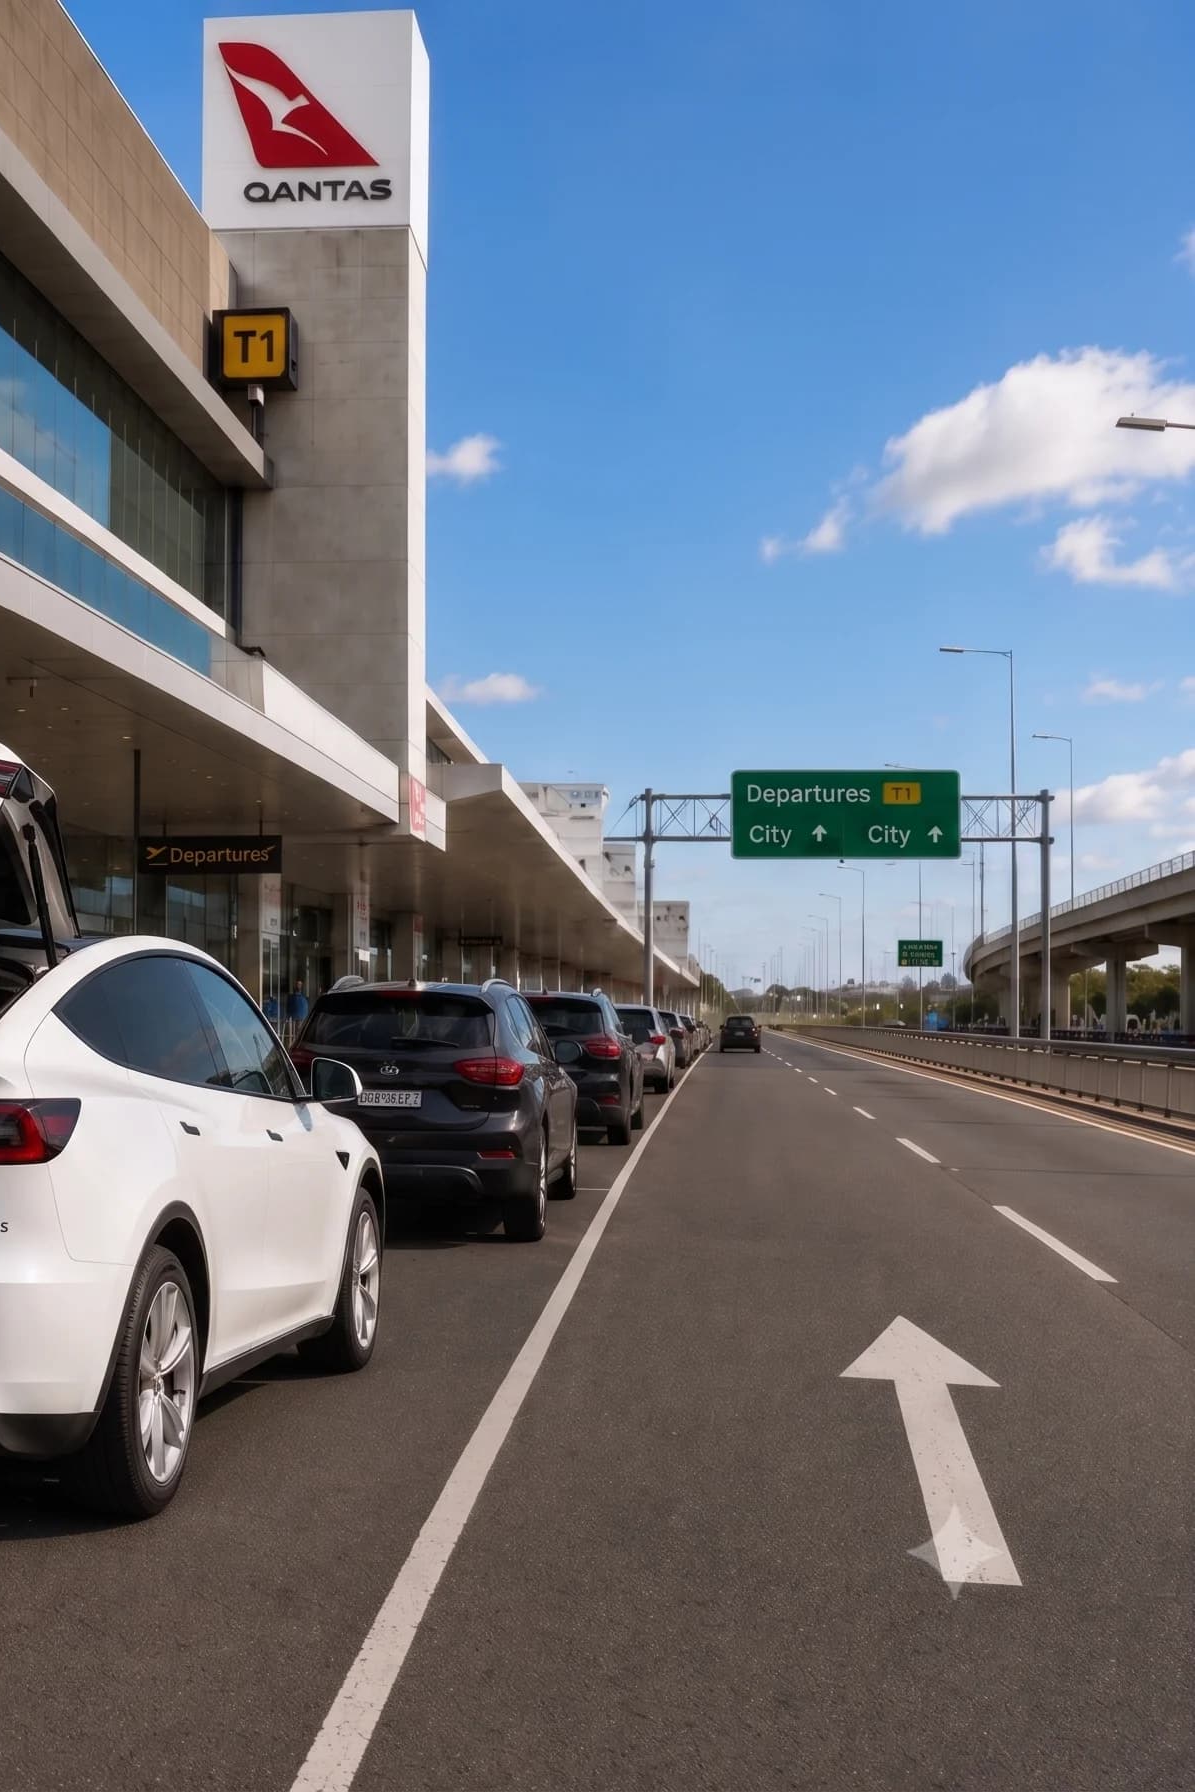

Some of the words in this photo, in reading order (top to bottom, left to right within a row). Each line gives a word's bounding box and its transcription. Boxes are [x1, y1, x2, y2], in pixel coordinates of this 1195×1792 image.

[243, 179, 392, 203] QANTAS
[233, 329, 274, 364] T1
[747, 784, 871, 807] Departures
[891, 787, 912, 801] T1
[749, 825, 792, 848] City
[868, 825, 911, 848] City
[170, 847, 270, 867] Departures
